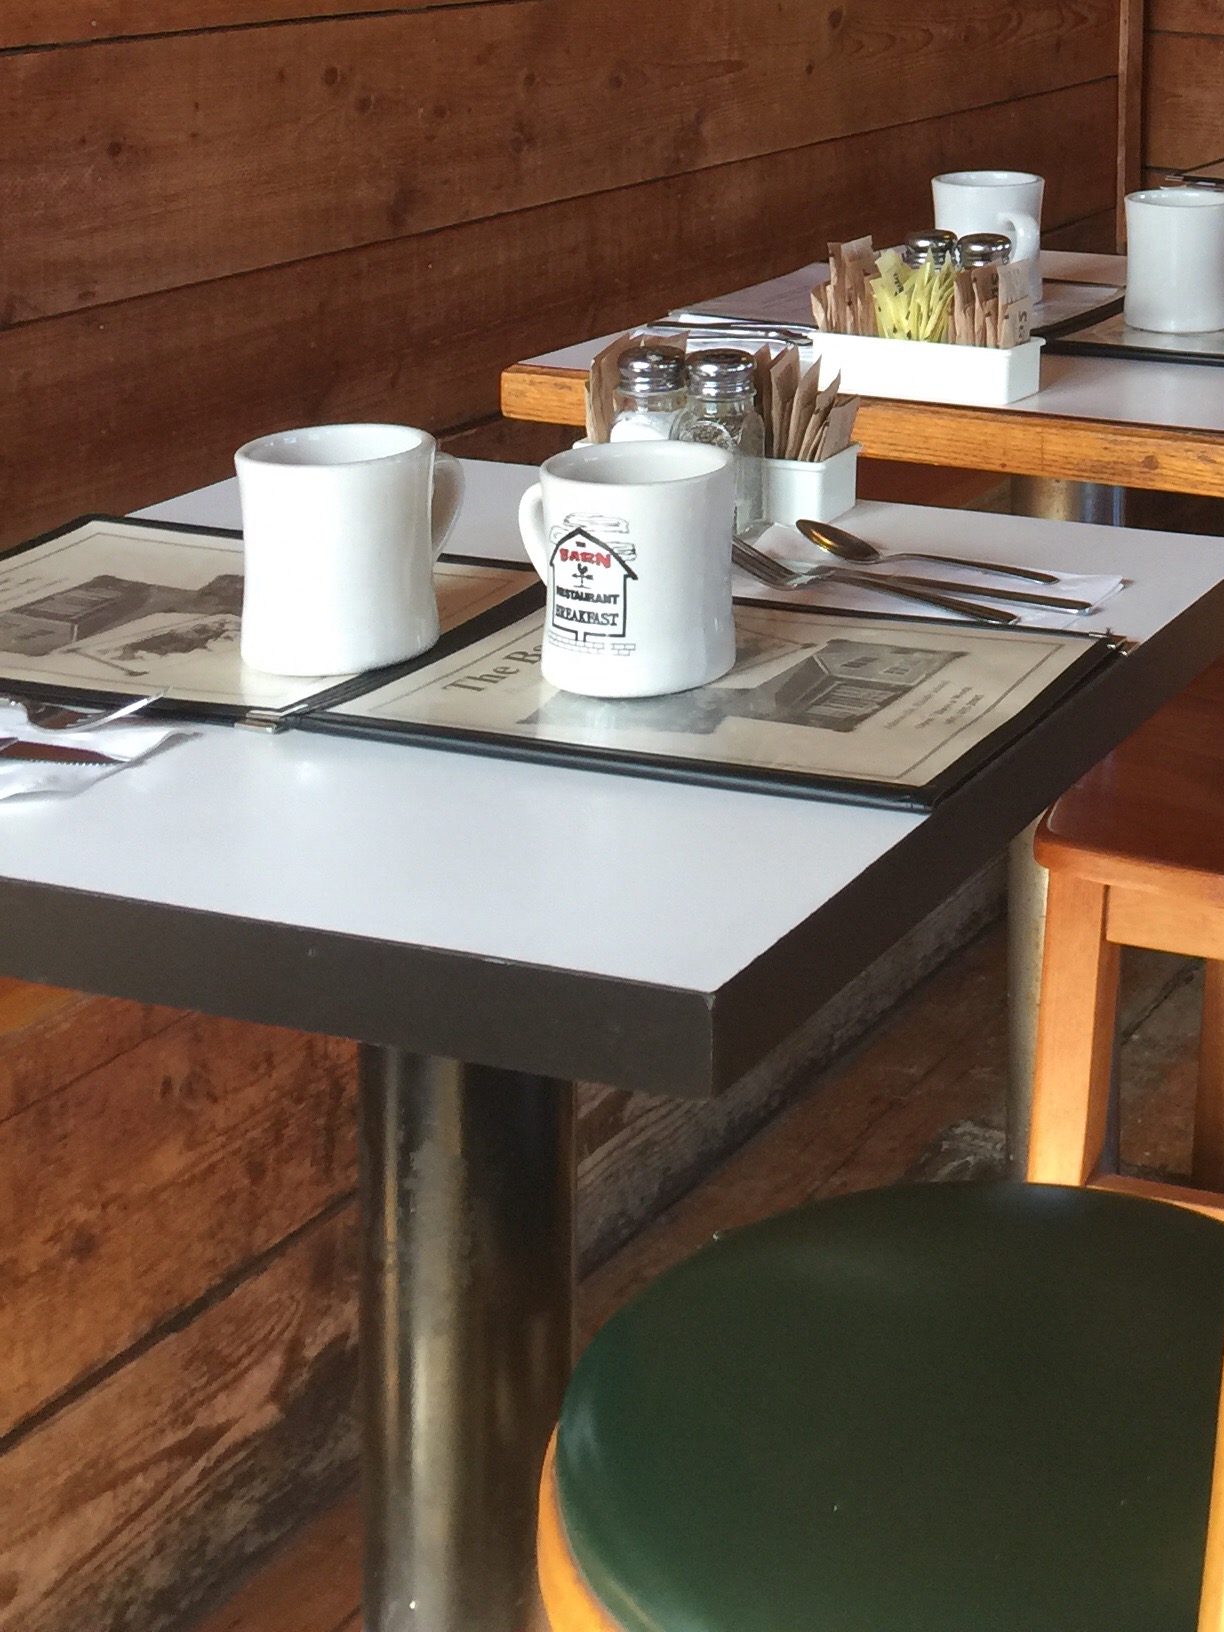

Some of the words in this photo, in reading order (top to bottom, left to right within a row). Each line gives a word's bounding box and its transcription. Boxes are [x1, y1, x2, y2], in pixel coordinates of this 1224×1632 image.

[559, 548, 611, 568] BARN
[556, 585, 620, 605] RESTAURANT
[555, 603, 619, 626] BREAKFAST
[441, 665, 520, 692] The
